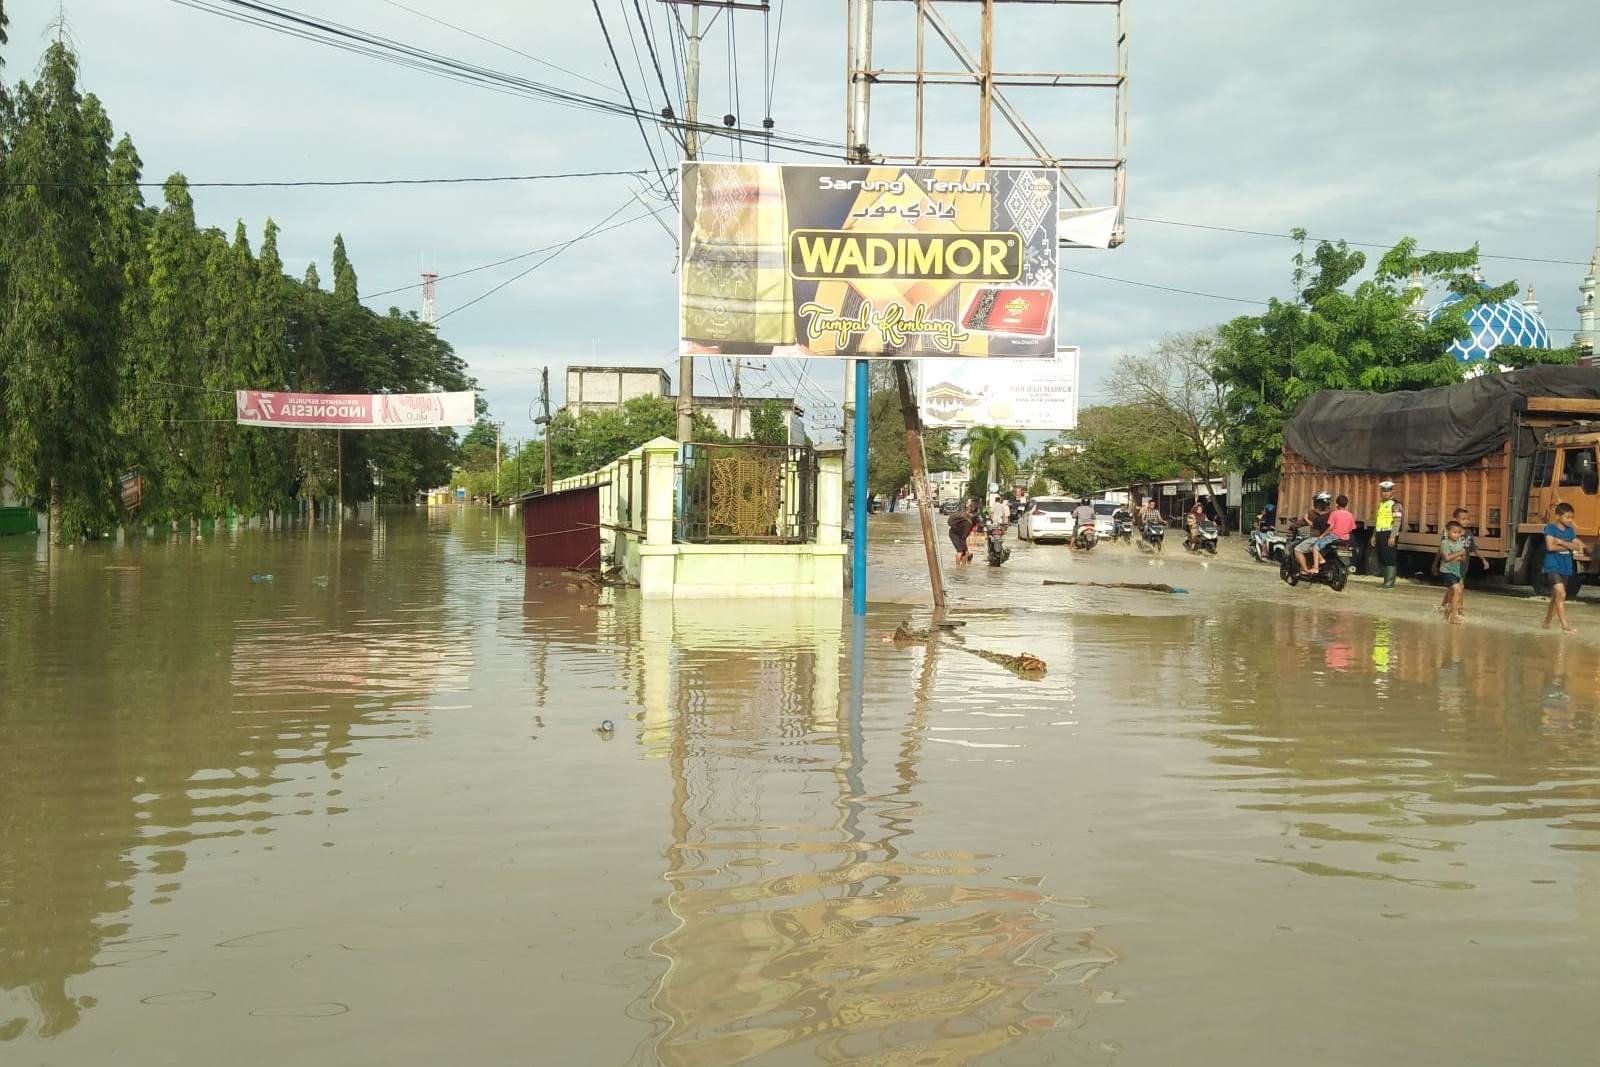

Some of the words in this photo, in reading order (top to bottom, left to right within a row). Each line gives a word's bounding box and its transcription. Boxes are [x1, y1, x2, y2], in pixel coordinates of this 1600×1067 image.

[819, 176, 903, 194] Sarung
[923, 178, 991, 192] Tenun
[798, 237, 1009, 275] WADIMOR
[802, 302, 871, 347] Tumpal
[873, 303, 968, 348] Kembang
